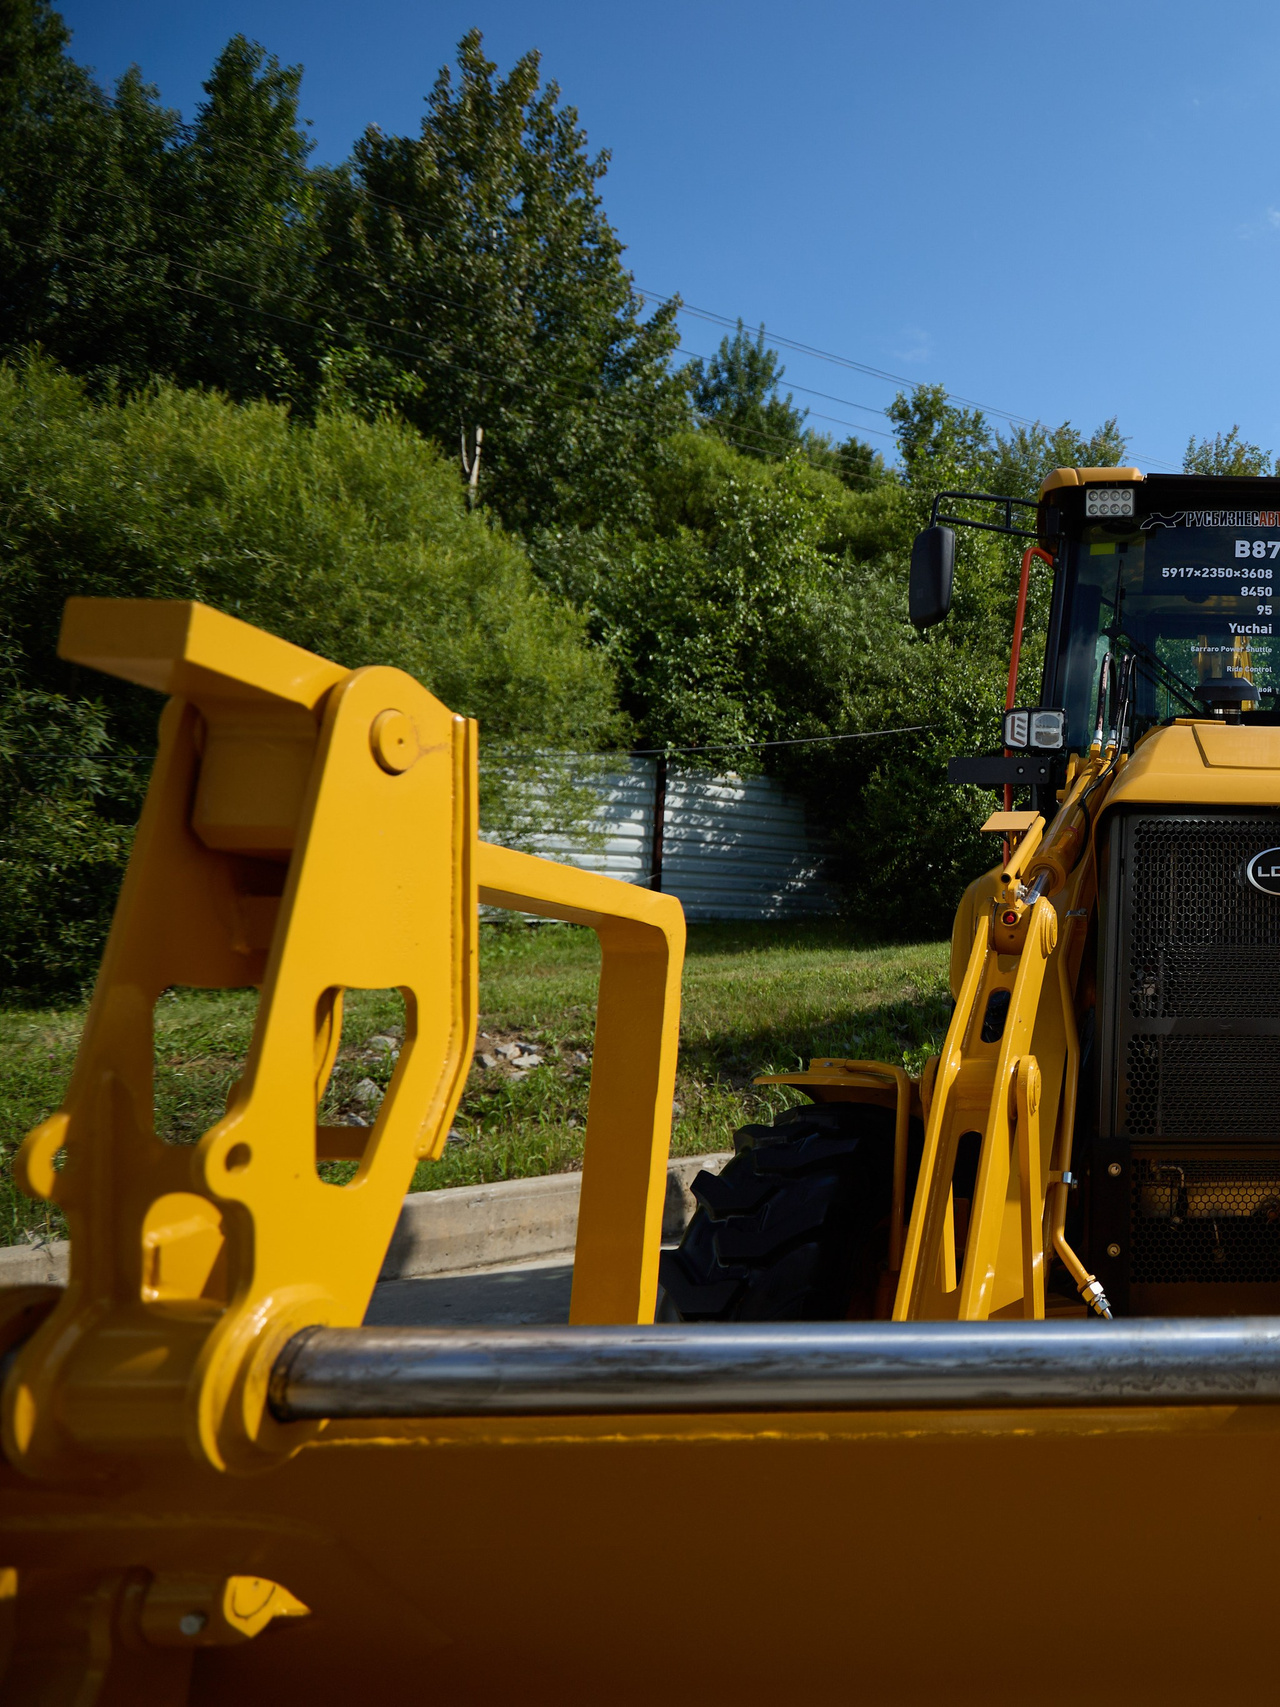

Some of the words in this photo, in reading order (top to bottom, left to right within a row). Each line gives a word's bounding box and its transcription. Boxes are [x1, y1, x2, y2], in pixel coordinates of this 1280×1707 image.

[1241, 586, 1273, 597] 8450
[1256, 605, 1273, 616] 95
[1228, 623, 1272, 634] Yuchai
